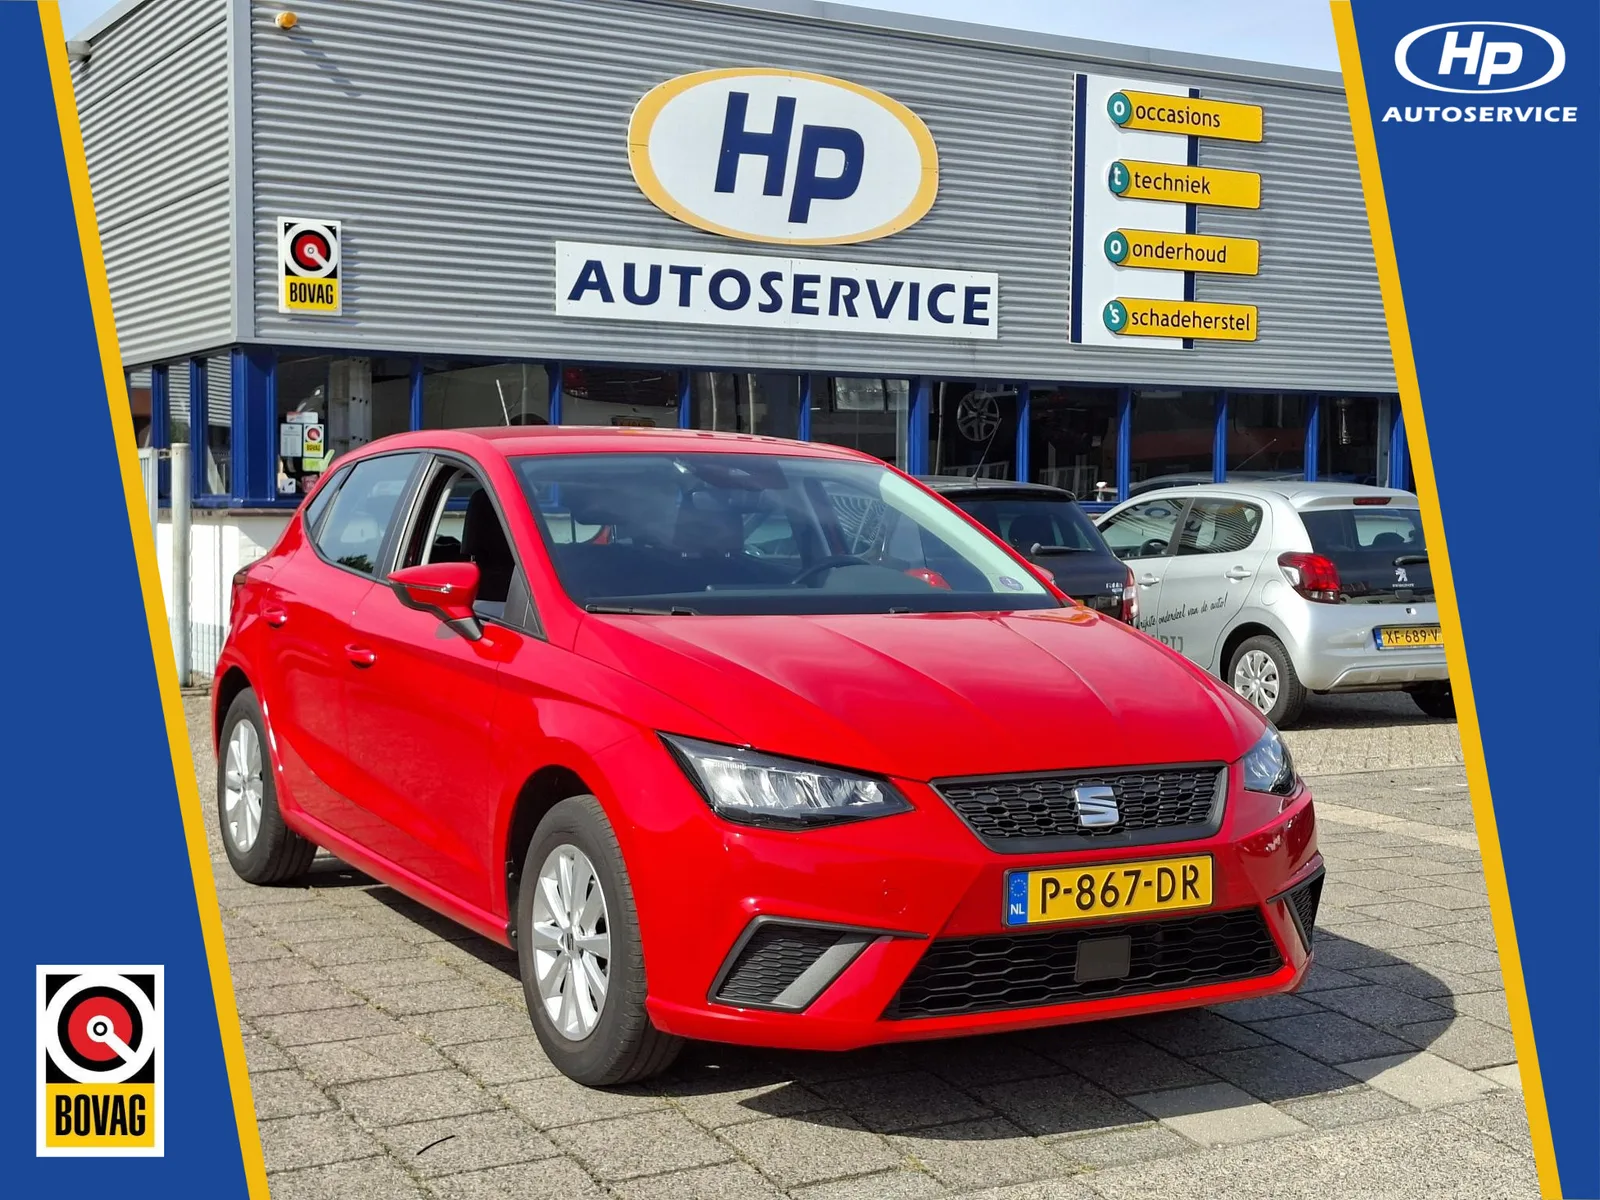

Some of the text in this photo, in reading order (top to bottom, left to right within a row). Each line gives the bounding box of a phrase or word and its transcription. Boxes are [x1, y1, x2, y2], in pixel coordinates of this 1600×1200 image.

[1135, 105, 1221, 128] occasions
[1134, 171, 1211, 195] techniek
[1132, 240, 1227, 263] onderhoud
[289, 282, 333, 305] BOVAG
[567, 259, 991, 327] AUTOSERVICE
[1131, 308, 1250, 331] schadeherstel
[1158, 603, 1186, 625] onderdeel
[1187, 606, 1198, 617] van
[1201, 600, 1208, 614] de
[1385, 628, 1442, 644] XF-689-V
[1010, 863, 1200, 915] NL P-867-DR
